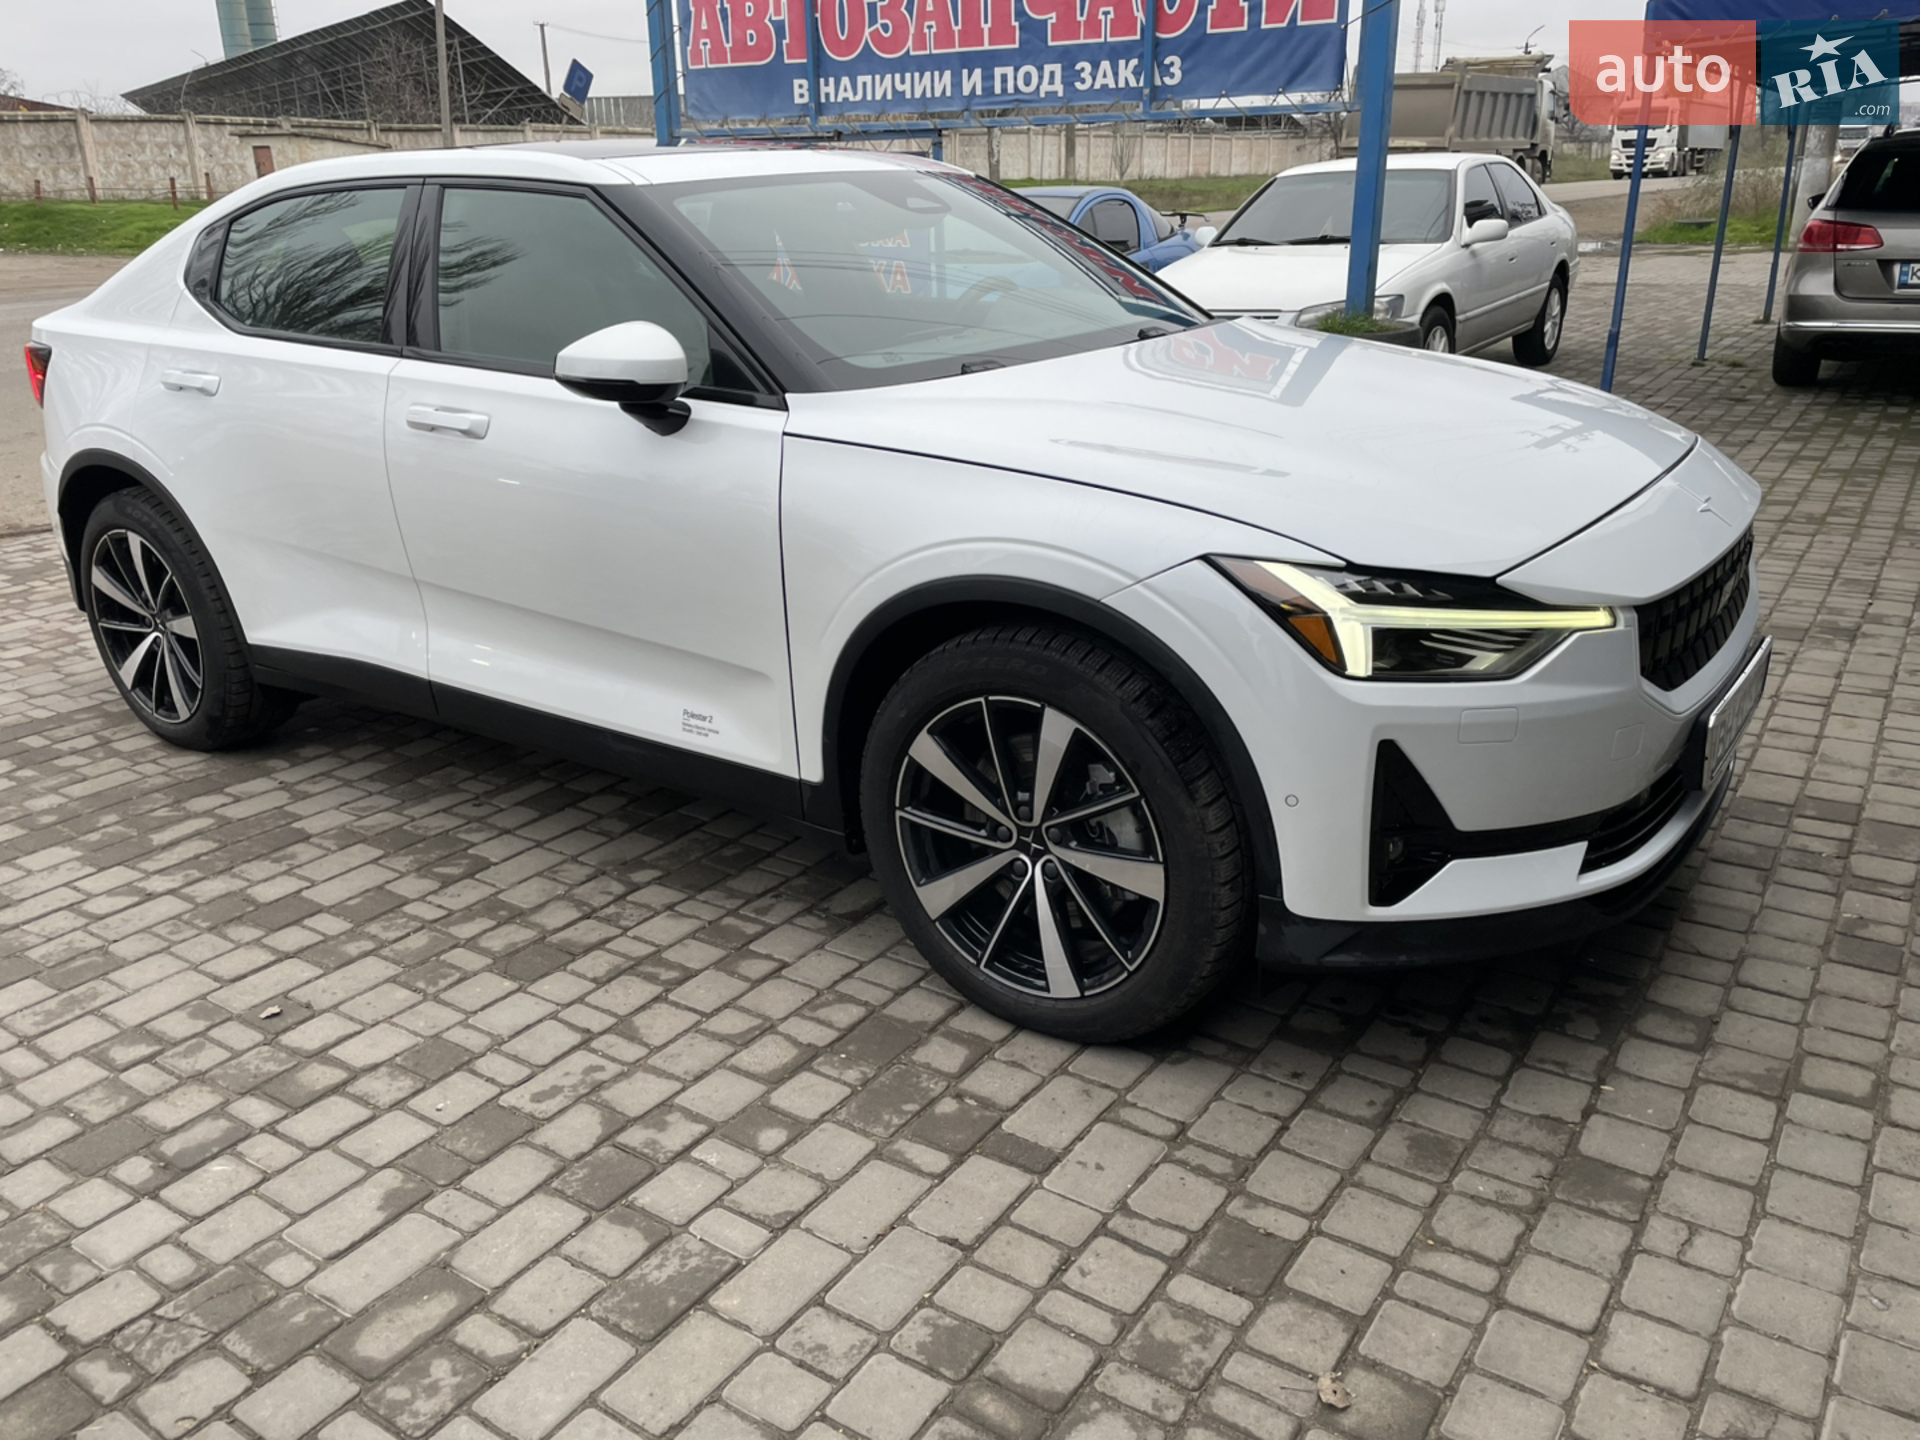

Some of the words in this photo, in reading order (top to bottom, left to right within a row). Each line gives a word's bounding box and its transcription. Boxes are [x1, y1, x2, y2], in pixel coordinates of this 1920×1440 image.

[687, 0, 1338, 69] АВТОЗАПЧ
[793, 78, 810, 105] В
[819, 69, 952, 103] НАЛИЧИИ
[962, 67, 983, 96] И
[994, 63, 1064, 98] ПОД
[682, 708, 708, 722] Polestar
